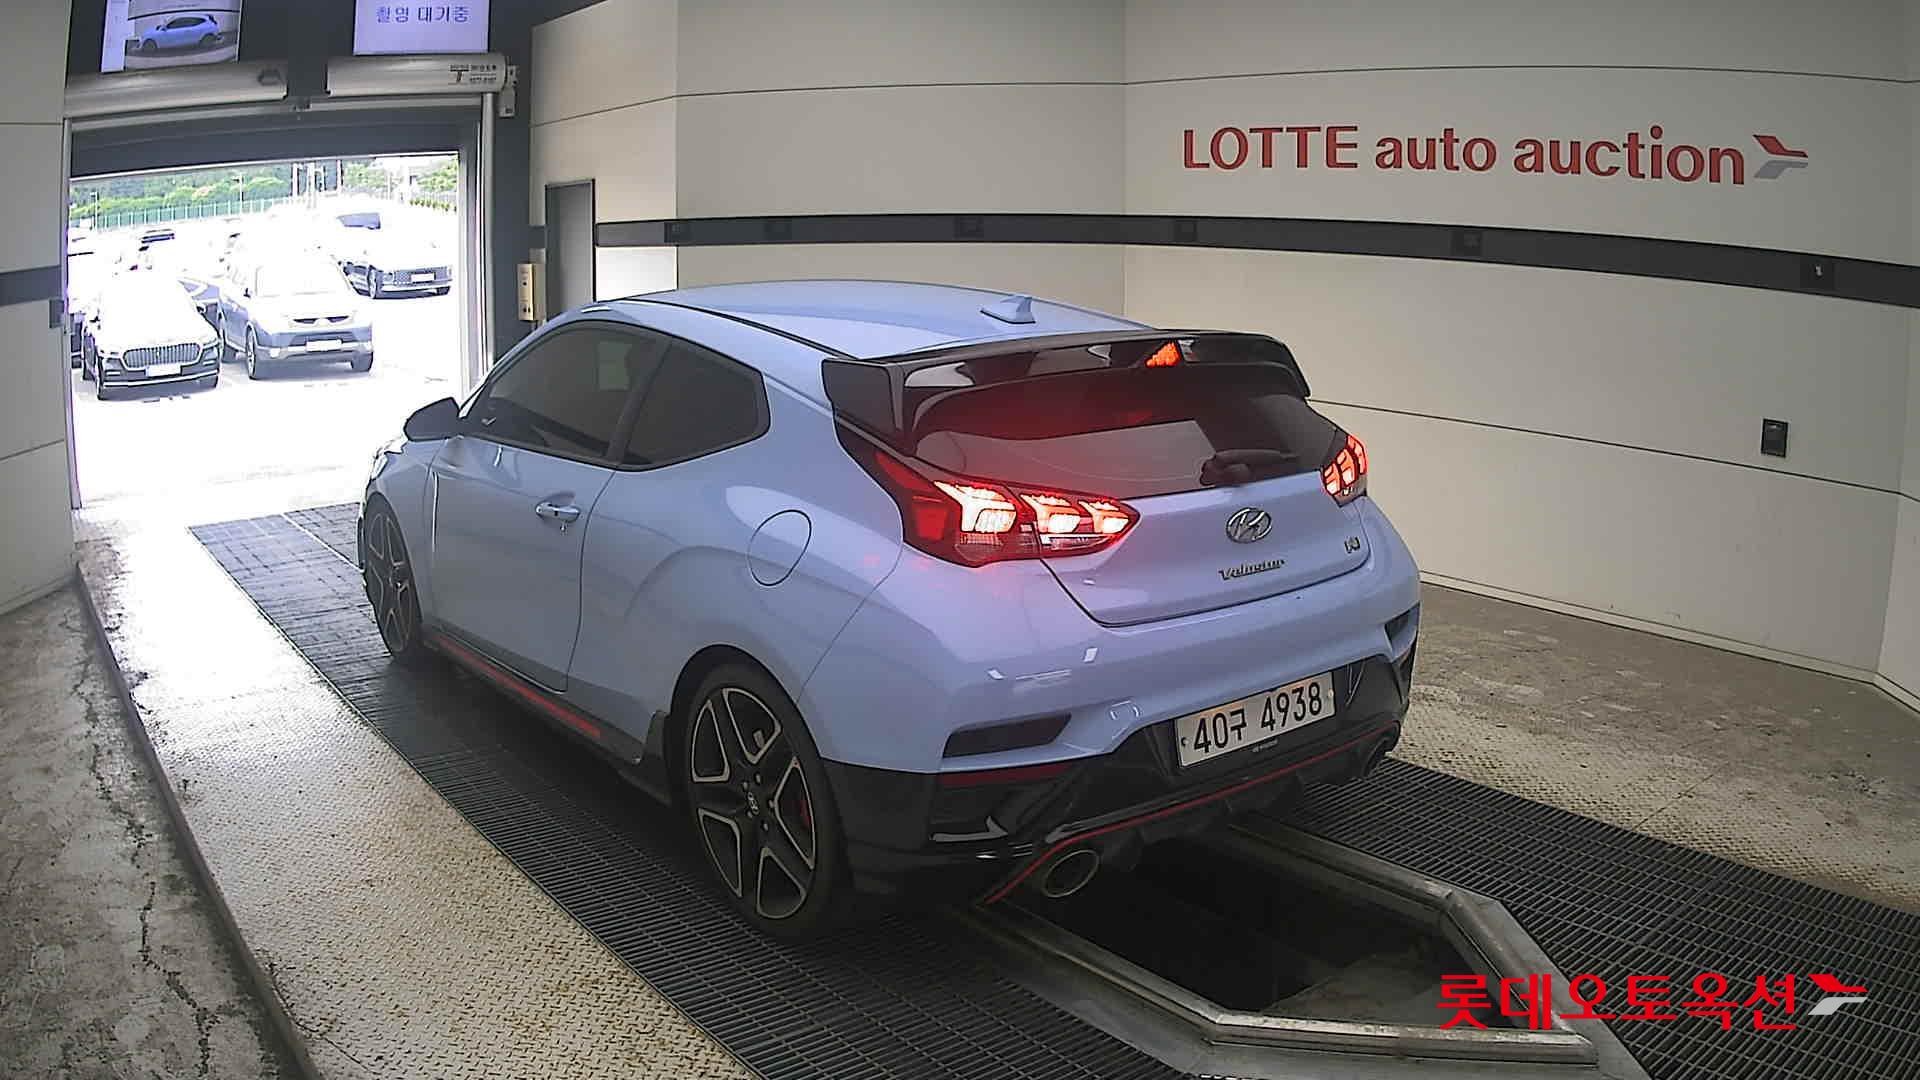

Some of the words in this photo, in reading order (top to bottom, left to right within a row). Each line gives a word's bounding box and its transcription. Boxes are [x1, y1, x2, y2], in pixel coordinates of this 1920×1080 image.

[418, 6, 468, 23] 대기중
[1183, 126, 1358, 169] LOTTE
[1375, 128, 1497, 171] auto
[1513, 126, 1745, 185] auction
[1193, 706, 1248, 754] 40구
[1260, 682, 1323, 732] 4938
